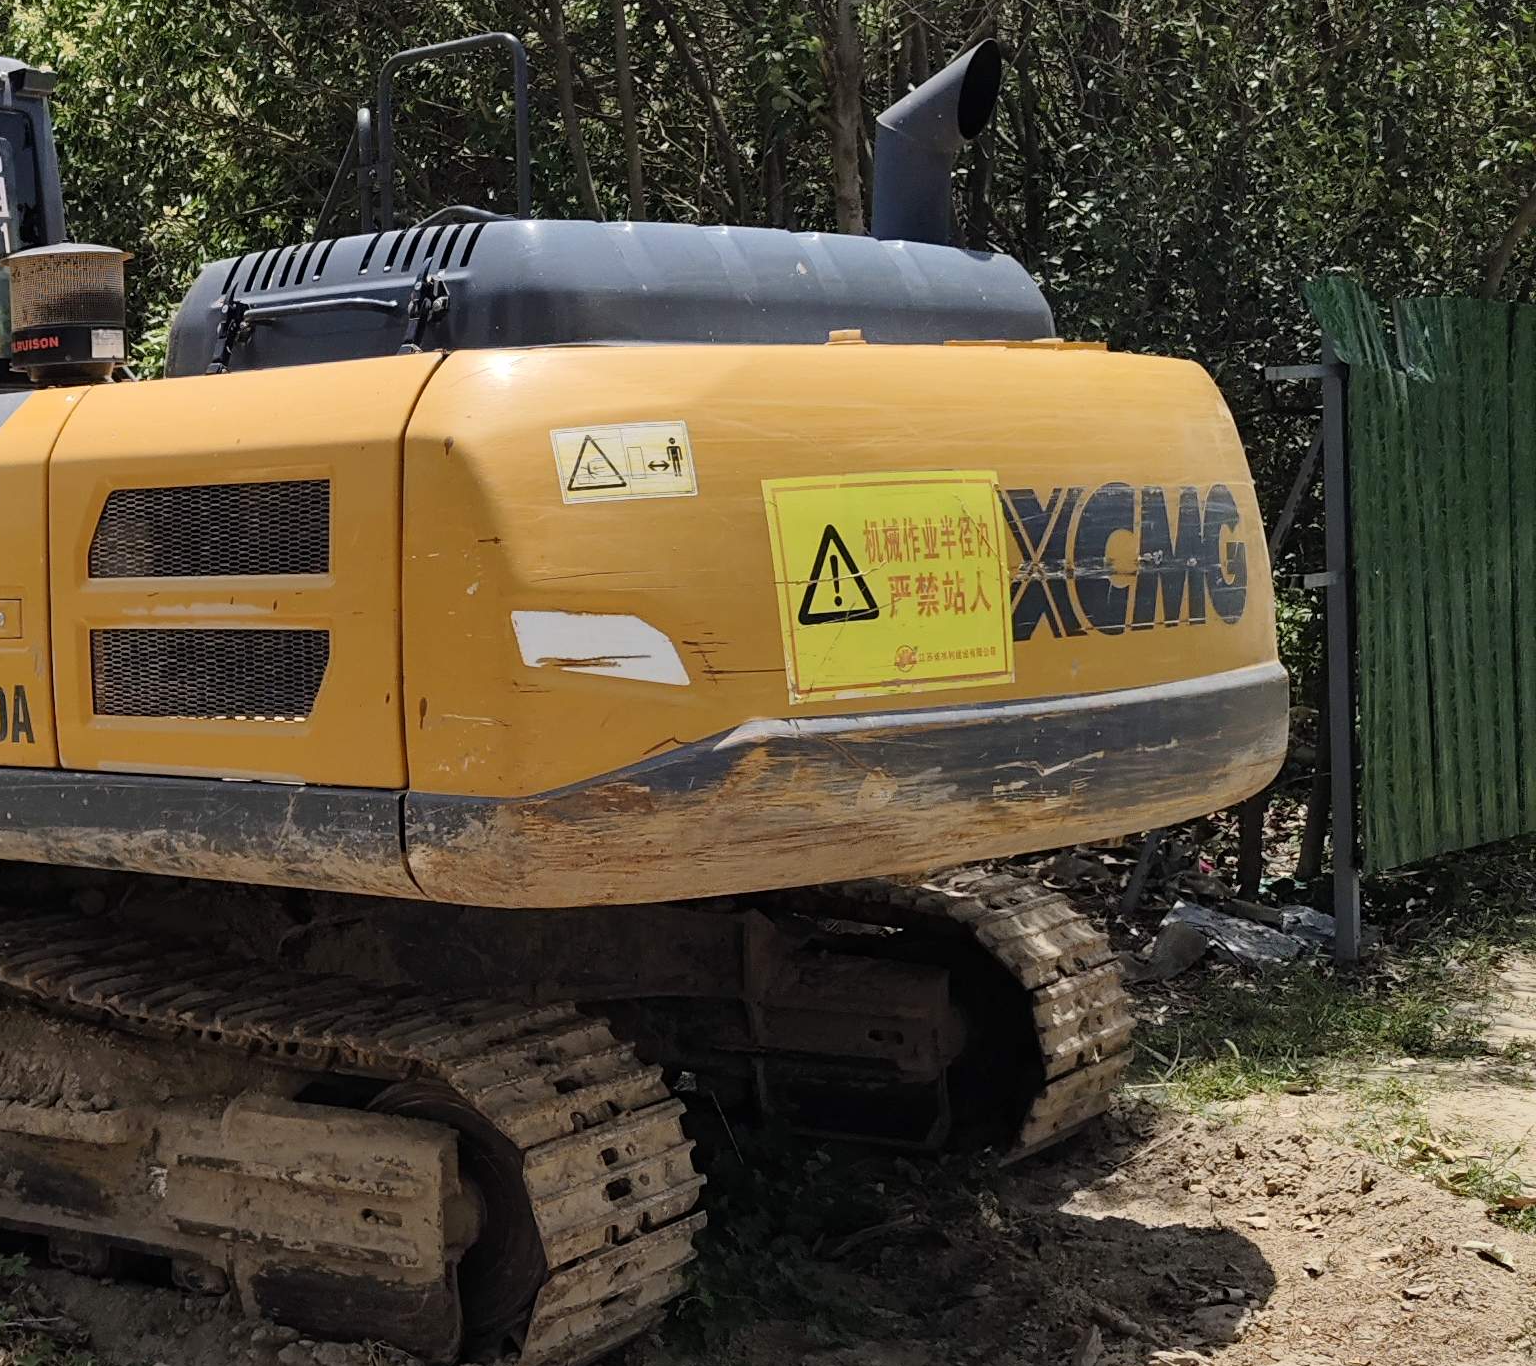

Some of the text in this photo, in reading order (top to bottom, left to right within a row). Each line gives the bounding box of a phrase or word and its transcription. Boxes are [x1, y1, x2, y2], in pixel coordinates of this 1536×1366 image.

[863, 514, 992, 564] 机械作业半径内
[997, 482, 1248, 642] XCMG
[887, 570, 992, 618] 严禁站人
